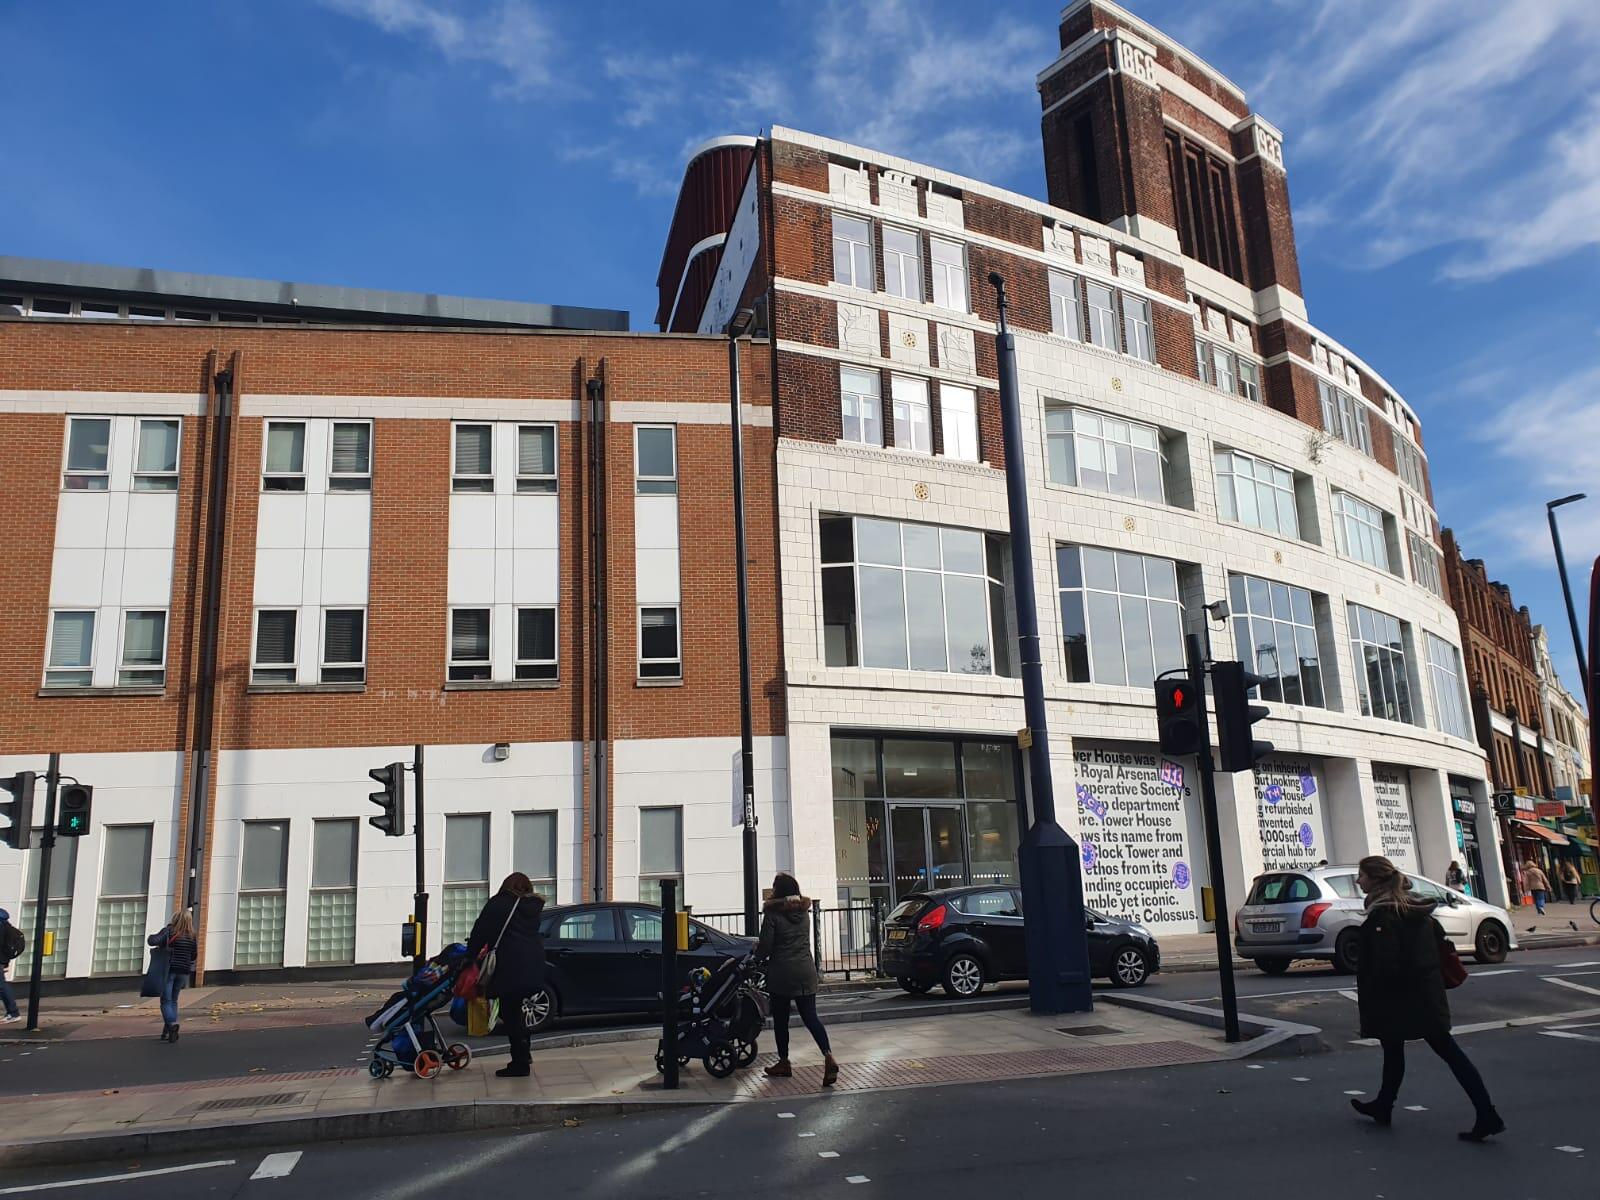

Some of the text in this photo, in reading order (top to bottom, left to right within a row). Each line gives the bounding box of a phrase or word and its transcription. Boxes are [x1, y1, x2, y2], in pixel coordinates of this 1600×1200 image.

[1094, 749, 1131, 764] House
[1134, 754, 1156, 765] was
[1081, 763, 1159, 782] Royal Arsenal
[1271, 773, 1300, 791] looking
[1140, 782, 1190, 800] Society's
[1112, 797, 1179, 815] department
[1265, 802, 1313, 815] refurbished
[1136, 813, 1171, 826] House
[1103, 829, 1118, 842] its
[1121, 832, 1153, 842] name
[1155, 829, 1183, 842] from
[1125, 844, 1159, 858] Tower
[1162, 844, 1183, 857] and
[1288, 844, 1303, 856] hub
[1121, 861, 1150, 874] from
[1152, 860, 1167, 874] its
[1124, 876, 1177, 894] occupier.
[1087, 892, 1179, 912] mble yet iconic.
[1143, 908, 1199, 923] Colossus.
